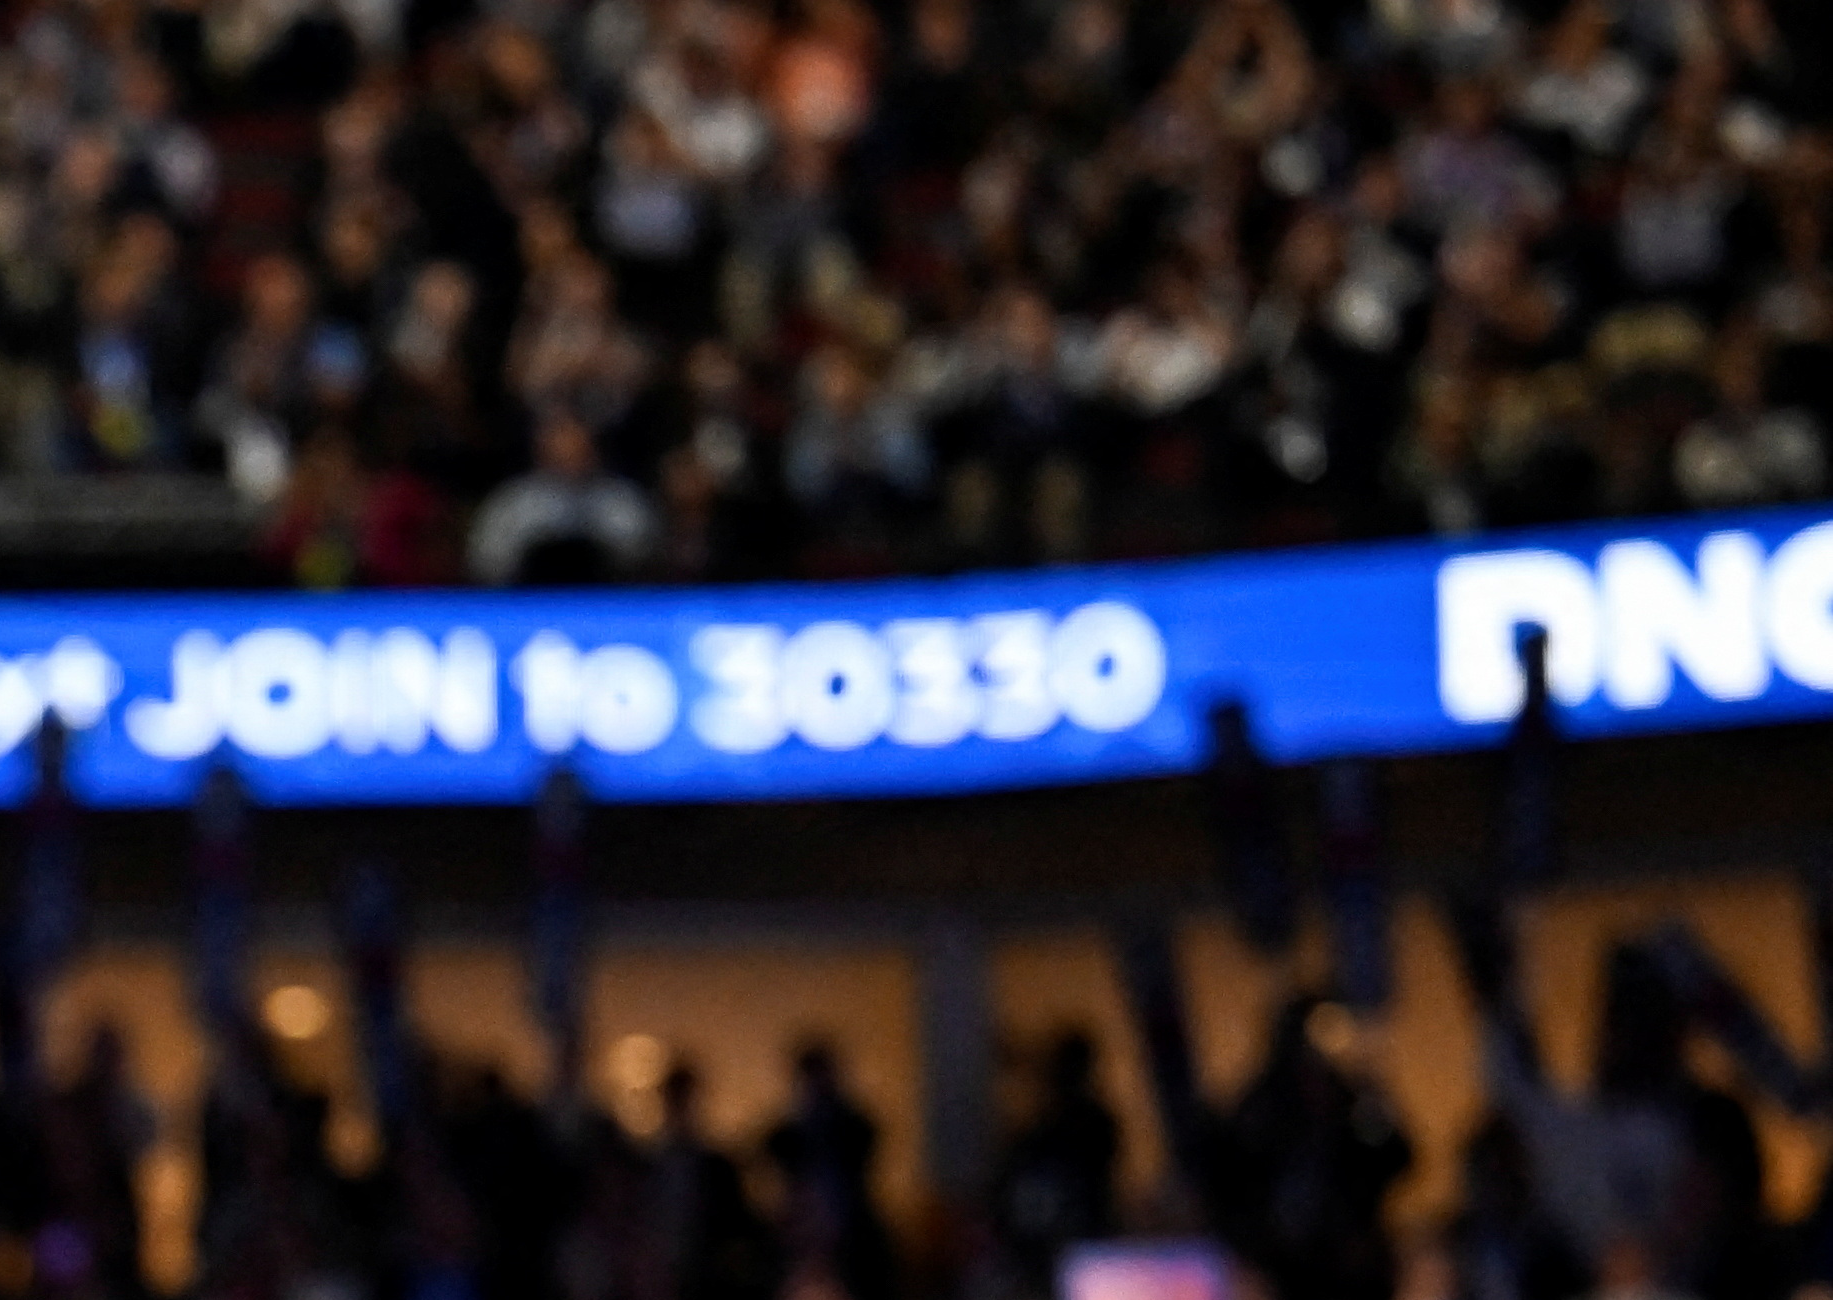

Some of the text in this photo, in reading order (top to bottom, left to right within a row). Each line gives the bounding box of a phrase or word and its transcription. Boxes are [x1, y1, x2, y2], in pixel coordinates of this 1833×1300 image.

[125, 625, 499, 759] JOIN
[509, 627, 680, 757] to
[690, 598, 1166, 753] 30330
